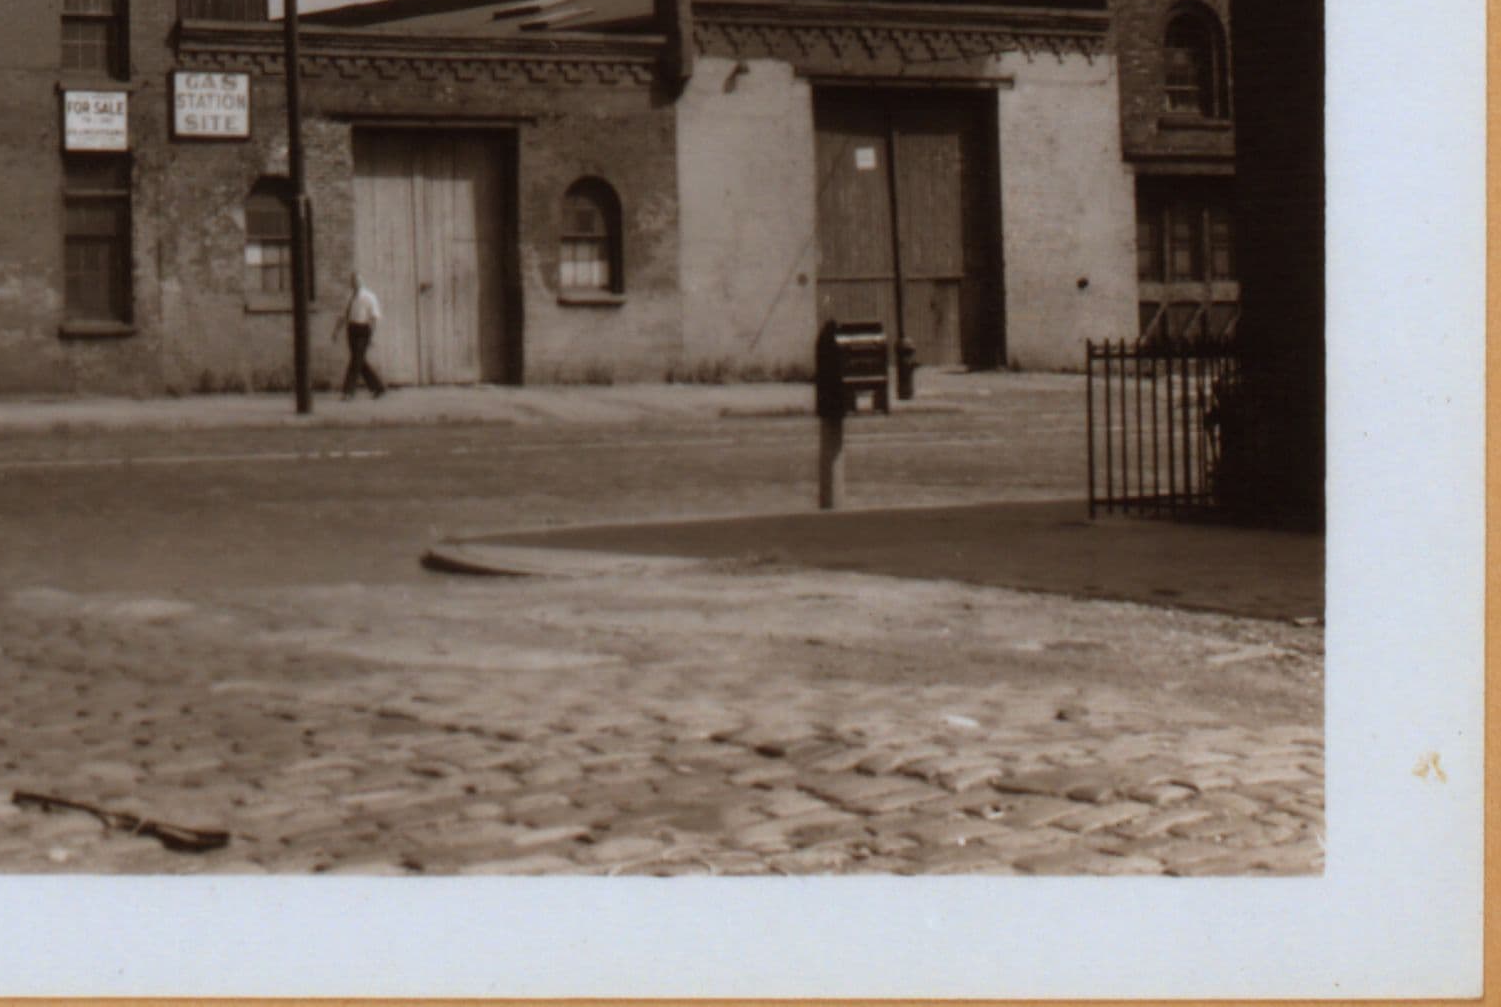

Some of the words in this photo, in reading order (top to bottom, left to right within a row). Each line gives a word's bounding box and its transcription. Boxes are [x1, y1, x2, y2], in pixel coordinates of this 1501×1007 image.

[185, 74, 238, 89] GAS
[67, 101, 90, 114] FOR
[94, 101, 124, 114] SALE
[178, 93, 246, 109] STATION
[185, 114, 238, 130] SITE
